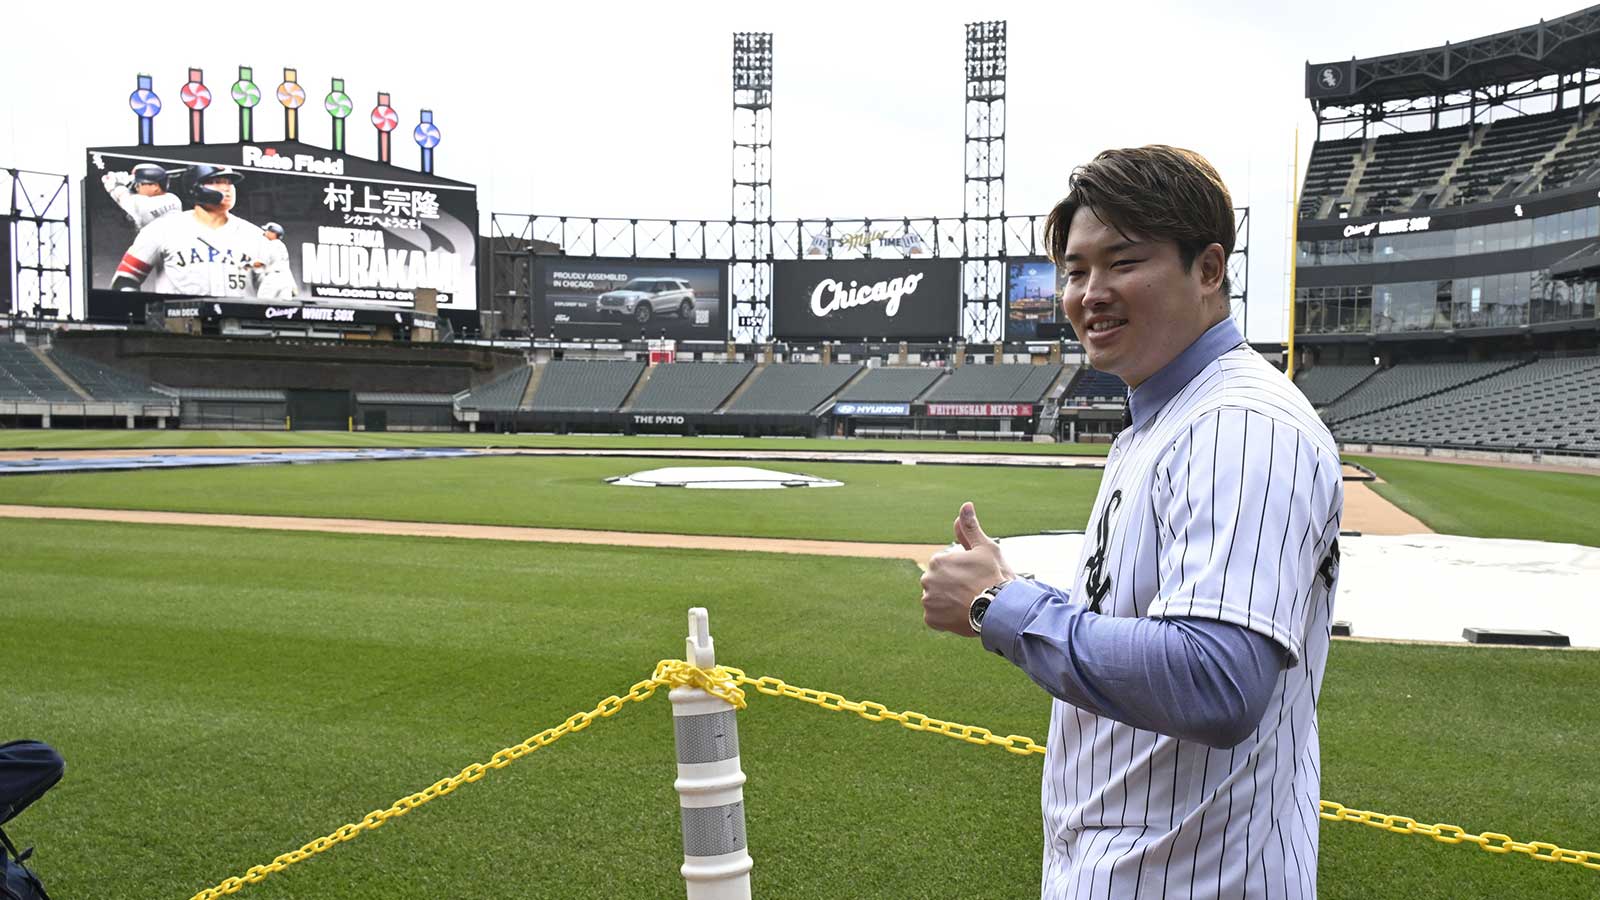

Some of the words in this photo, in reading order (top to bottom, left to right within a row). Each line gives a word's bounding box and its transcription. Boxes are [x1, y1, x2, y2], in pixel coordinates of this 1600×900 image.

[294, 154, 344, 175] Field
[323, 182, 440, 219] 村上宗隆
[228, 274, 246, 290] 55
[553, 272, 586, 280] PROUDLY
[587, 273, 628, 281] ASSEMBLED
[317, 287, 377, 299] WELCOME
[378, 291, 395, 300] TO
[811, 272, 923, 317] Chicago
[302, 308, 334, 320] WHITE
[334, 309, 355, 321] SOX
[929, 404, 987, 415] WHITTINGHAM
[990, 404, 1018, 415] MEATS
[634, 416, 653, 424] THE
[656, 416, 684, 424] PATIO
